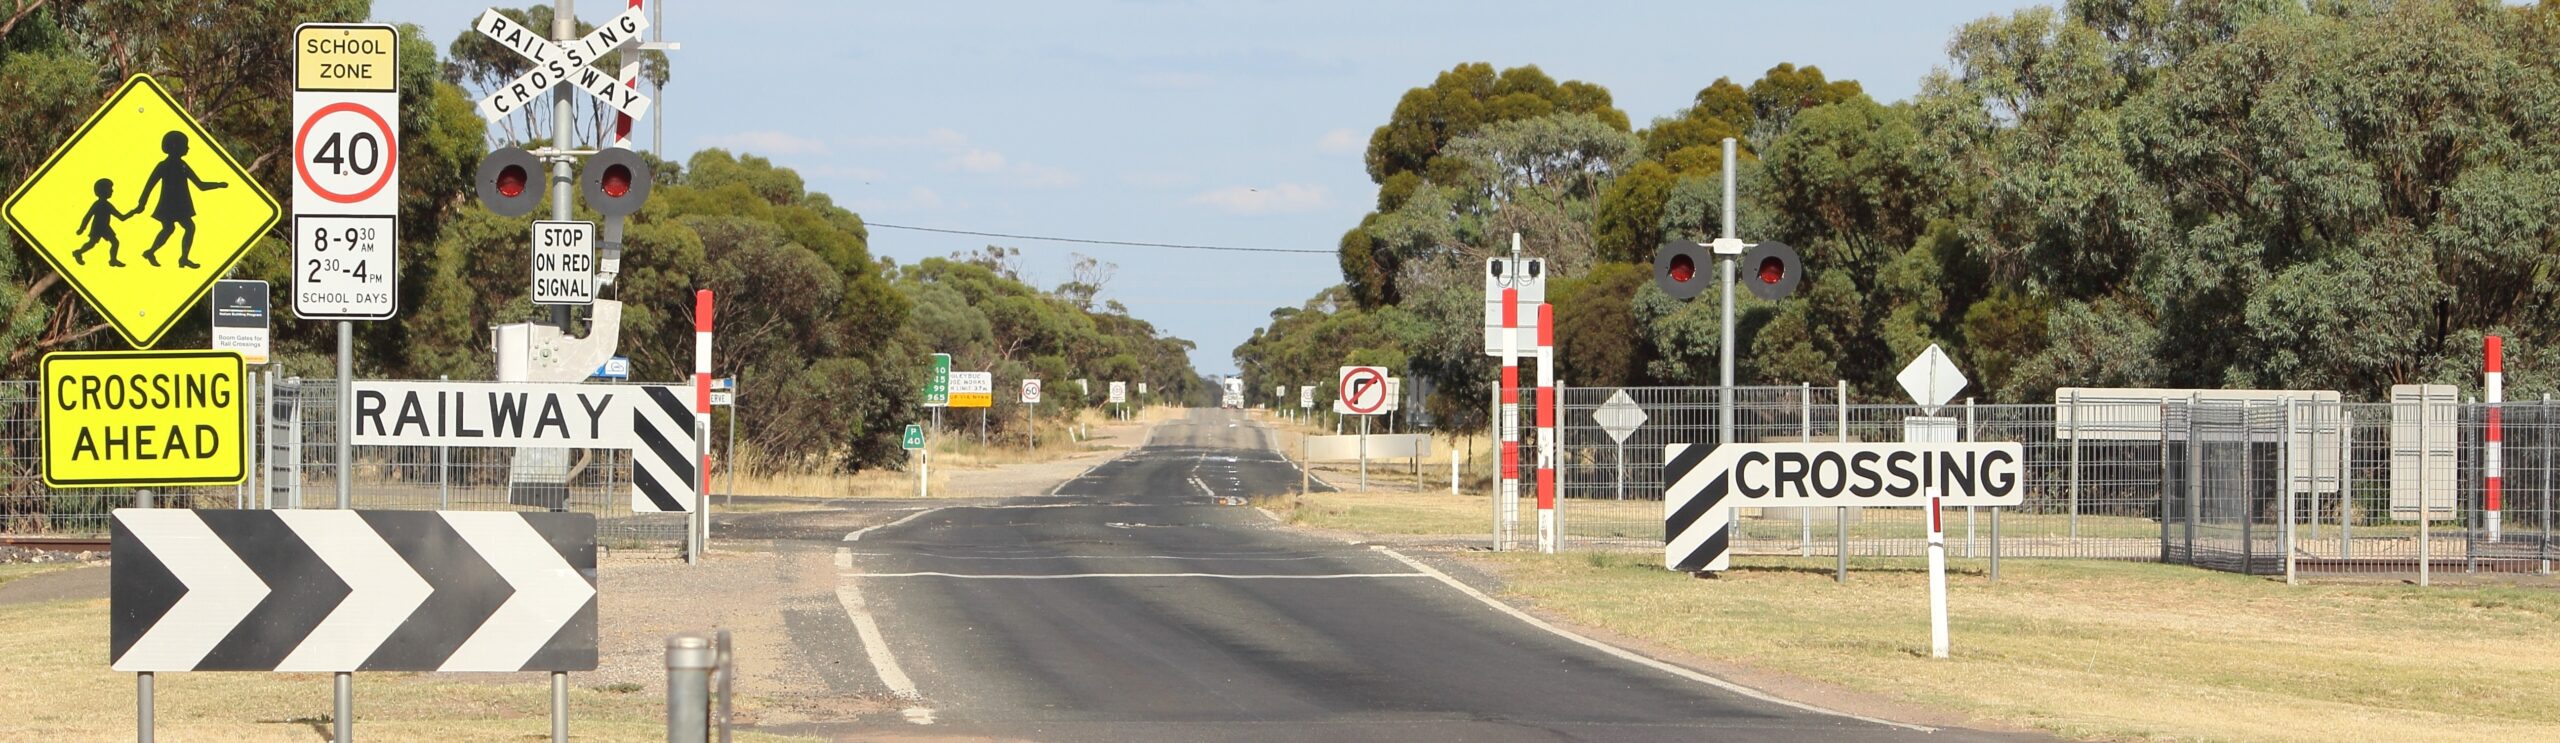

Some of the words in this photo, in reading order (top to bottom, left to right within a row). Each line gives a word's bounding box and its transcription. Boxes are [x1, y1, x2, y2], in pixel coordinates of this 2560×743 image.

[306, 39, 386, 54] SCHOOL
[320, 63, 373, 79] ZONE
[493, 16, 636, 113] CROSSING
[312, 131, 379, 176] 40
[544, 228, 583, 247] STOP
[360, 243, 374, 252] AM
[536, 253, 555, 271] ON
[562, 254, 590, 272] RED
[369, 274, 382, 283] PM
[537, 278, 589, 297] SIGNAL
[302, 293, 349, 303] SCHOOL
[356, 293, 388, 304] DAYS
[57, 372, 231, 411] CROSSING
[1025, 386, 1037, 395] 60
[356, 389, 614, 439] RAILWAY
[907, 437, 921, 445] 40
[910, 428, 917, 436] P
[71, 424, 219, 461] AHEAD
[1735, 449, 2015, 499] CROSSING
